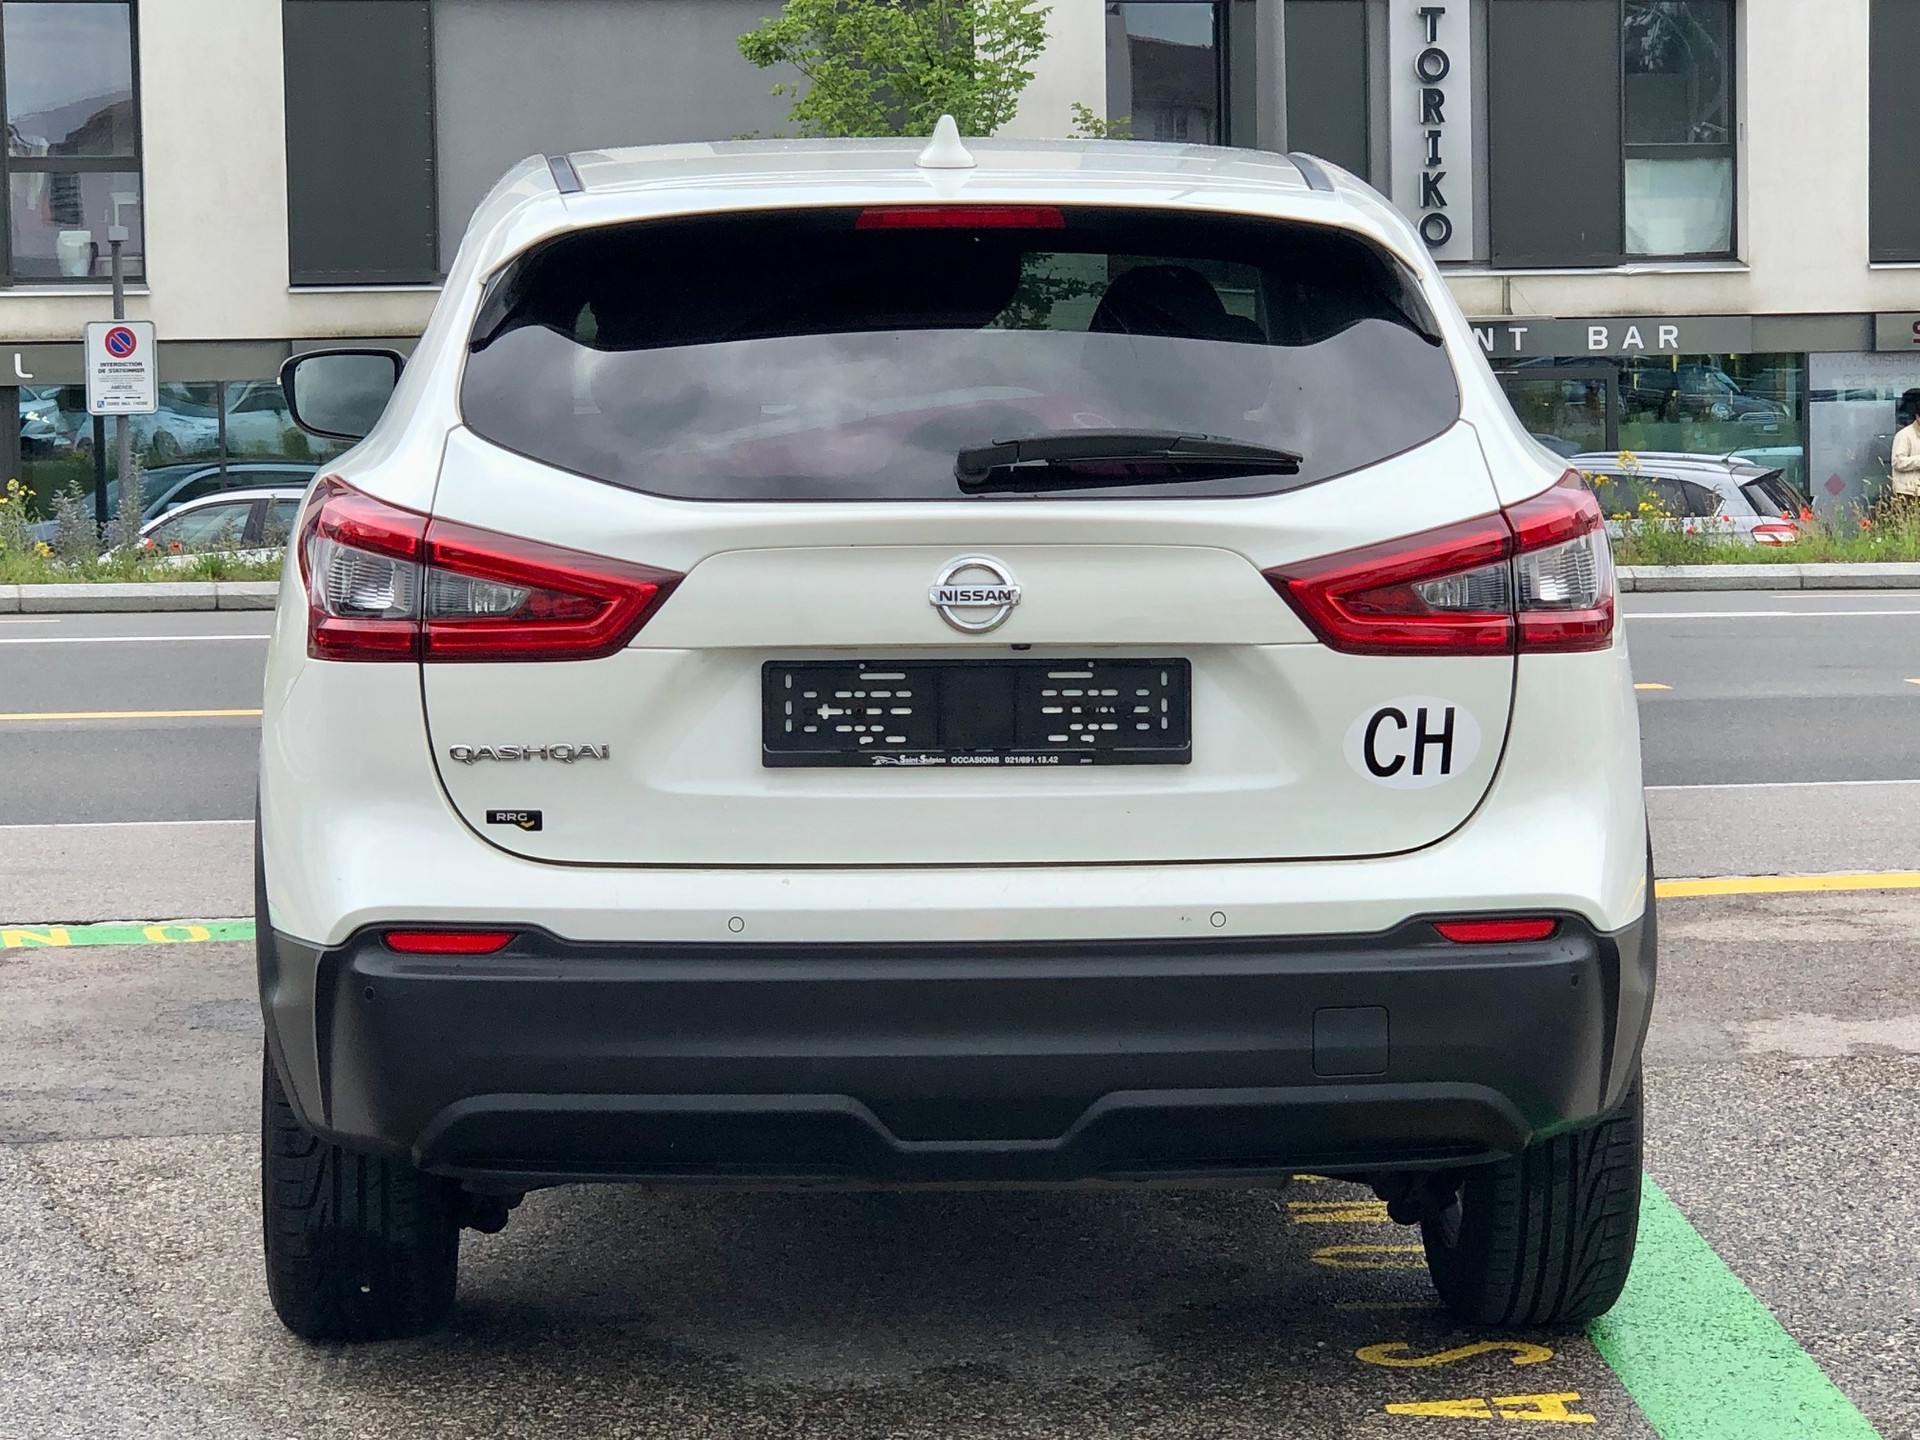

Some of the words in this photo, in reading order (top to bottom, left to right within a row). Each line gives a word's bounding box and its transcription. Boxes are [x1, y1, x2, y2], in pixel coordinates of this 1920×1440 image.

[1414, 7, 1452, 247] TORIKO
[1588, 325, 1679, 350] BAR
[14, 353, 34, 379] L
[939, 589, 1012, 602] NISSAN
[1363, 706, 1456, 778] CH
[449, 743, 611, 766] QASHQAI
[950, 755, 1000, 764] OCCASIONS
[495, 811, 529, 822] RRG
